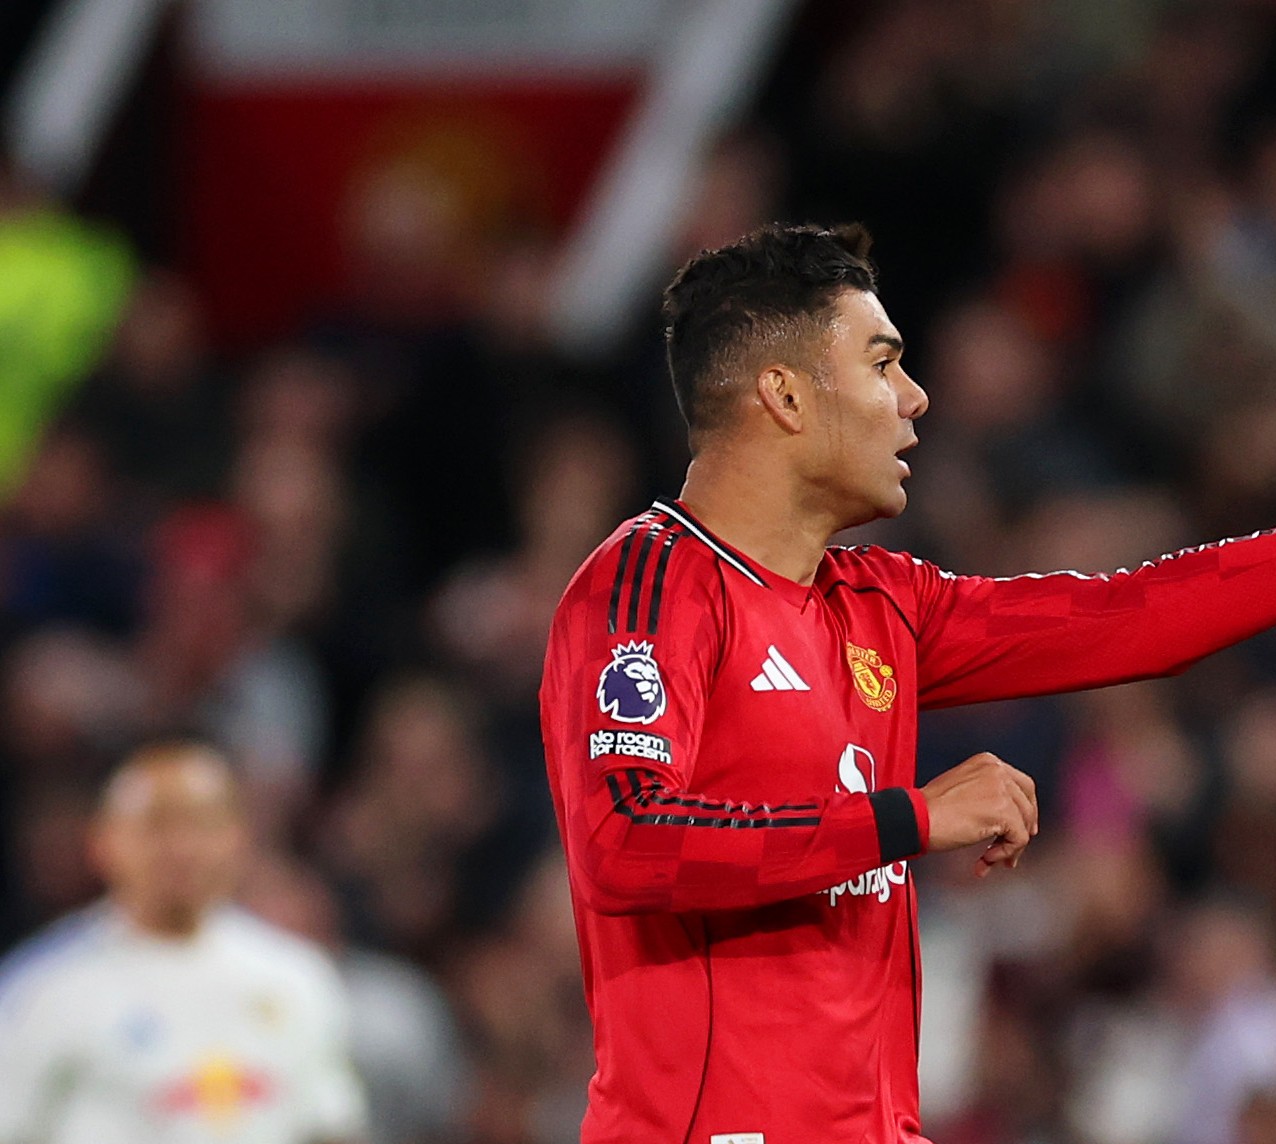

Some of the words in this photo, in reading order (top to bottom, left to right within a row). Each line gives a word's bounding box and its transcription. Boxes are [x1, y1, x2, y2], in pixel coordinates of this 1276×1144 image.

[590, 730, 615, 744] No
[617, 732, 664, 751] room
[615, 744, 672, 765] racism
